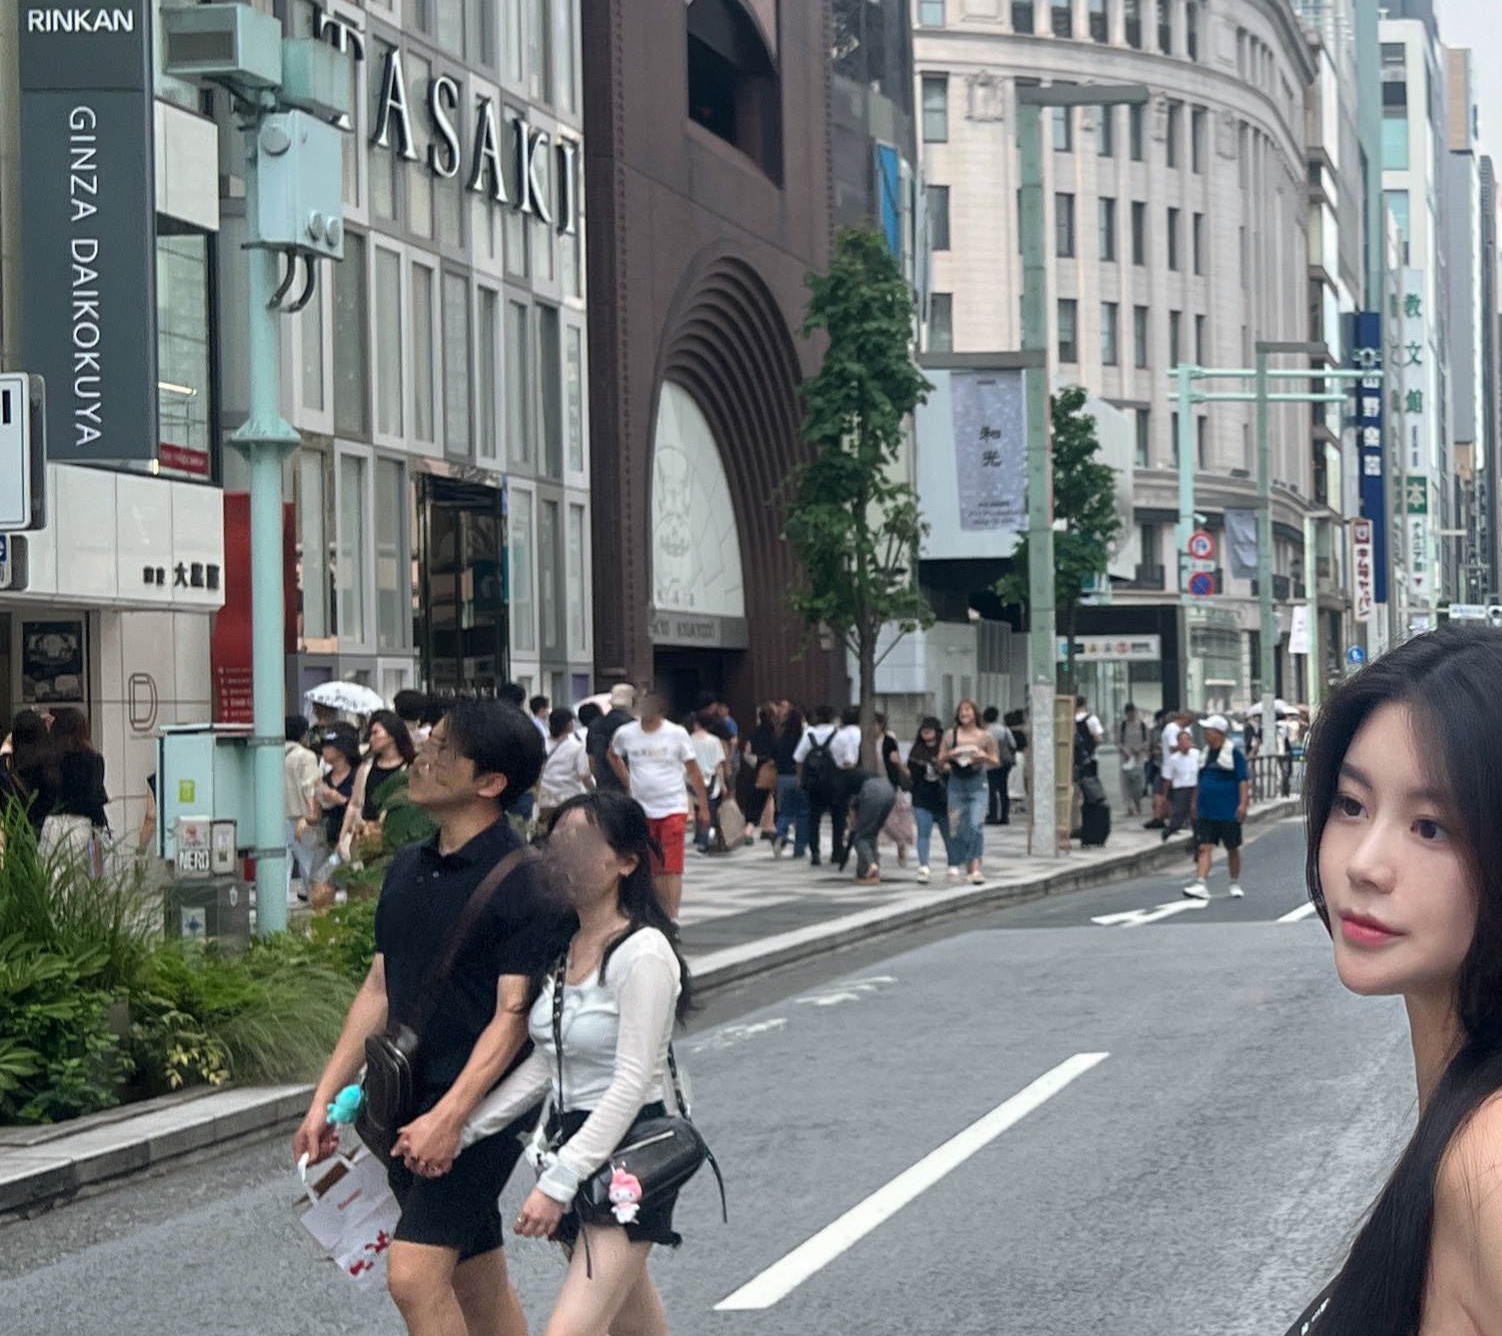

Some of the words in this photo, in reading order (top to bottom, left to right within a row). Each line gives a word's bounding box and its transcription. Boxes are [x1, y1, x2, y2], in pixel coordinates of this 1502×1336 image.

[28, 9, 134, 32] RINKAN
[70, 106, 98, 222] GINZA
[312, 11, 578, 234] TASAKI
[72, 240, 102, 447] DAIKOKUYA
[1405, 293, 1423, 413] 教文館
[979, 425, 1002, 467] 和光
